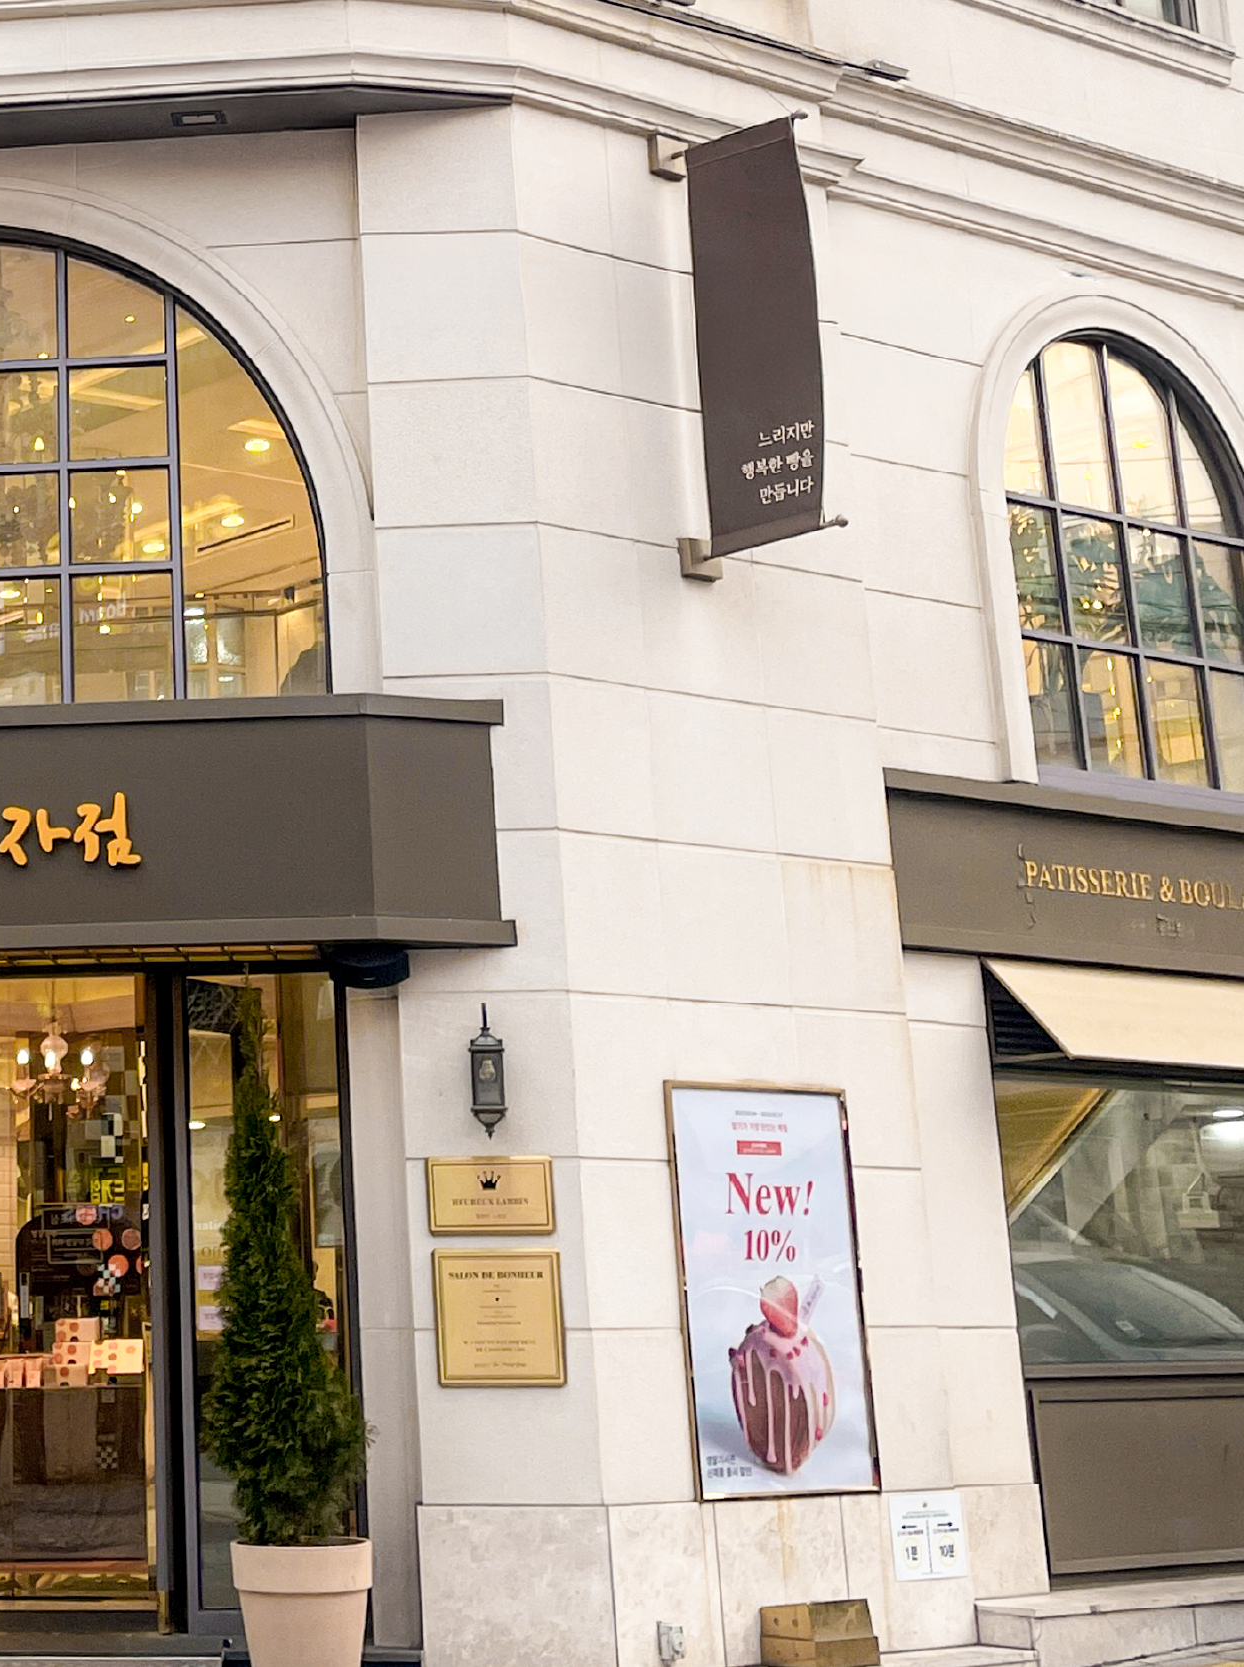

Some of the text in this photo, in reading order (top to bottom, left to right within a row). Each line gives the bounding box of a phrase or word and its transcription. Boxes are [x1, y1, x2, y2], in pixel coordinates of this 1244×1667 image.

[758, 419, 815, 447] 느리지만
[741, 448, 815, 480] 행복한 빵을
[759, 475, 815, 505] 만듭니다
[1025, 859, 1244, 911] PATISSERIE & BOUL
[725, 1172, 813, 1216] New!
[744, 1229, 796, 1262] 10%
[448, 1271, 479, 1280] SALON
